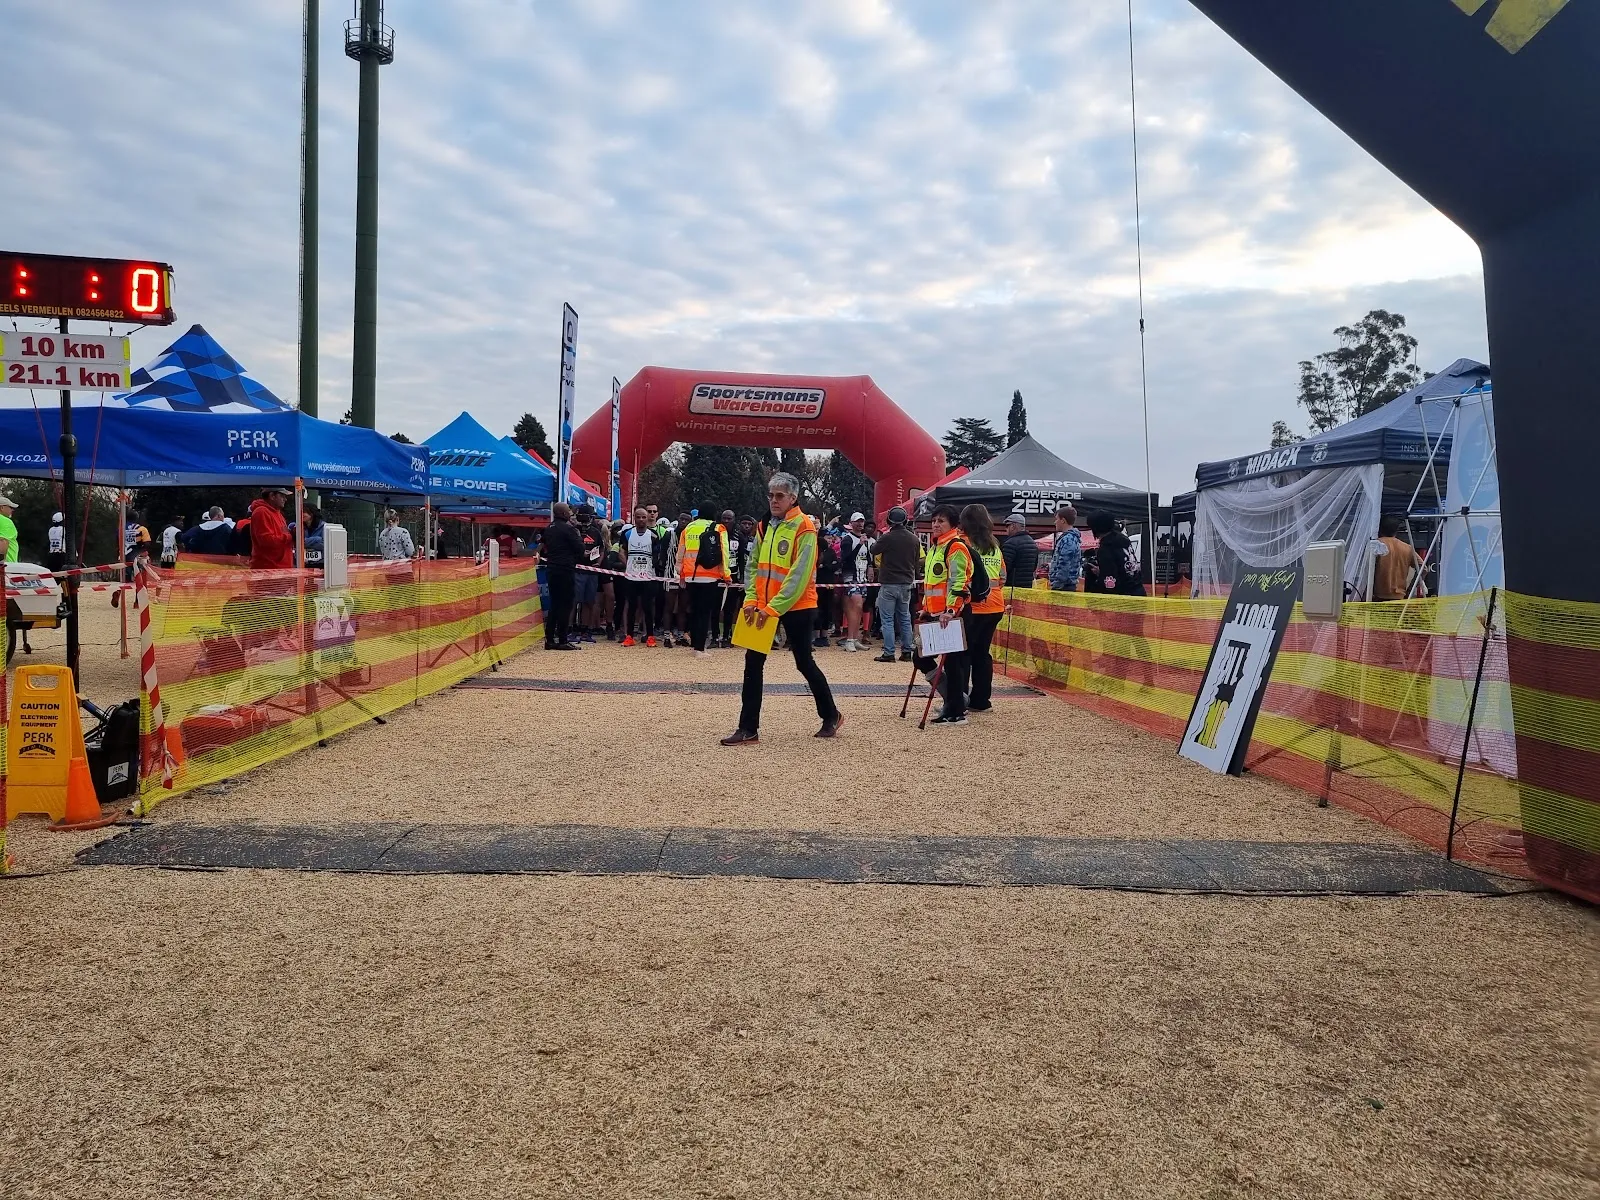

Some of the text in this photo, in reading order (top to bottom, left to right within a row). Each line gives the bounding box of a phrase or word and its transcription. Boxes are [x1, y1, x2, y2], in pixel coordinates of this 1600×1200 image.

[132, 268, 159, 312] 0
[21, 304, 73, 316] VERMEULEN
[75, 307, 124, 319] 0824564822
[21, 336, 105, 359] 10 km
[8, 363, 120, 388] 21.1 km
[696, 386, 820, 403] Sportsmans
[712, 398, 817, 415] Warehouse
[675, 420, 837, 436] winning starts here!
[227, 429, 279, 448] PEAK
[229, 451, 279, 465] TIMING
[453, 448, 497, 456] WAIT
[1245, 446, 1301, 476] MIDACK
[443, 477, 452, 488] is
[453, 478, 508, 492] POWER
[1235, 603, 1279, 630] ROUTE
[23, 732, 54, 743] PEAK
